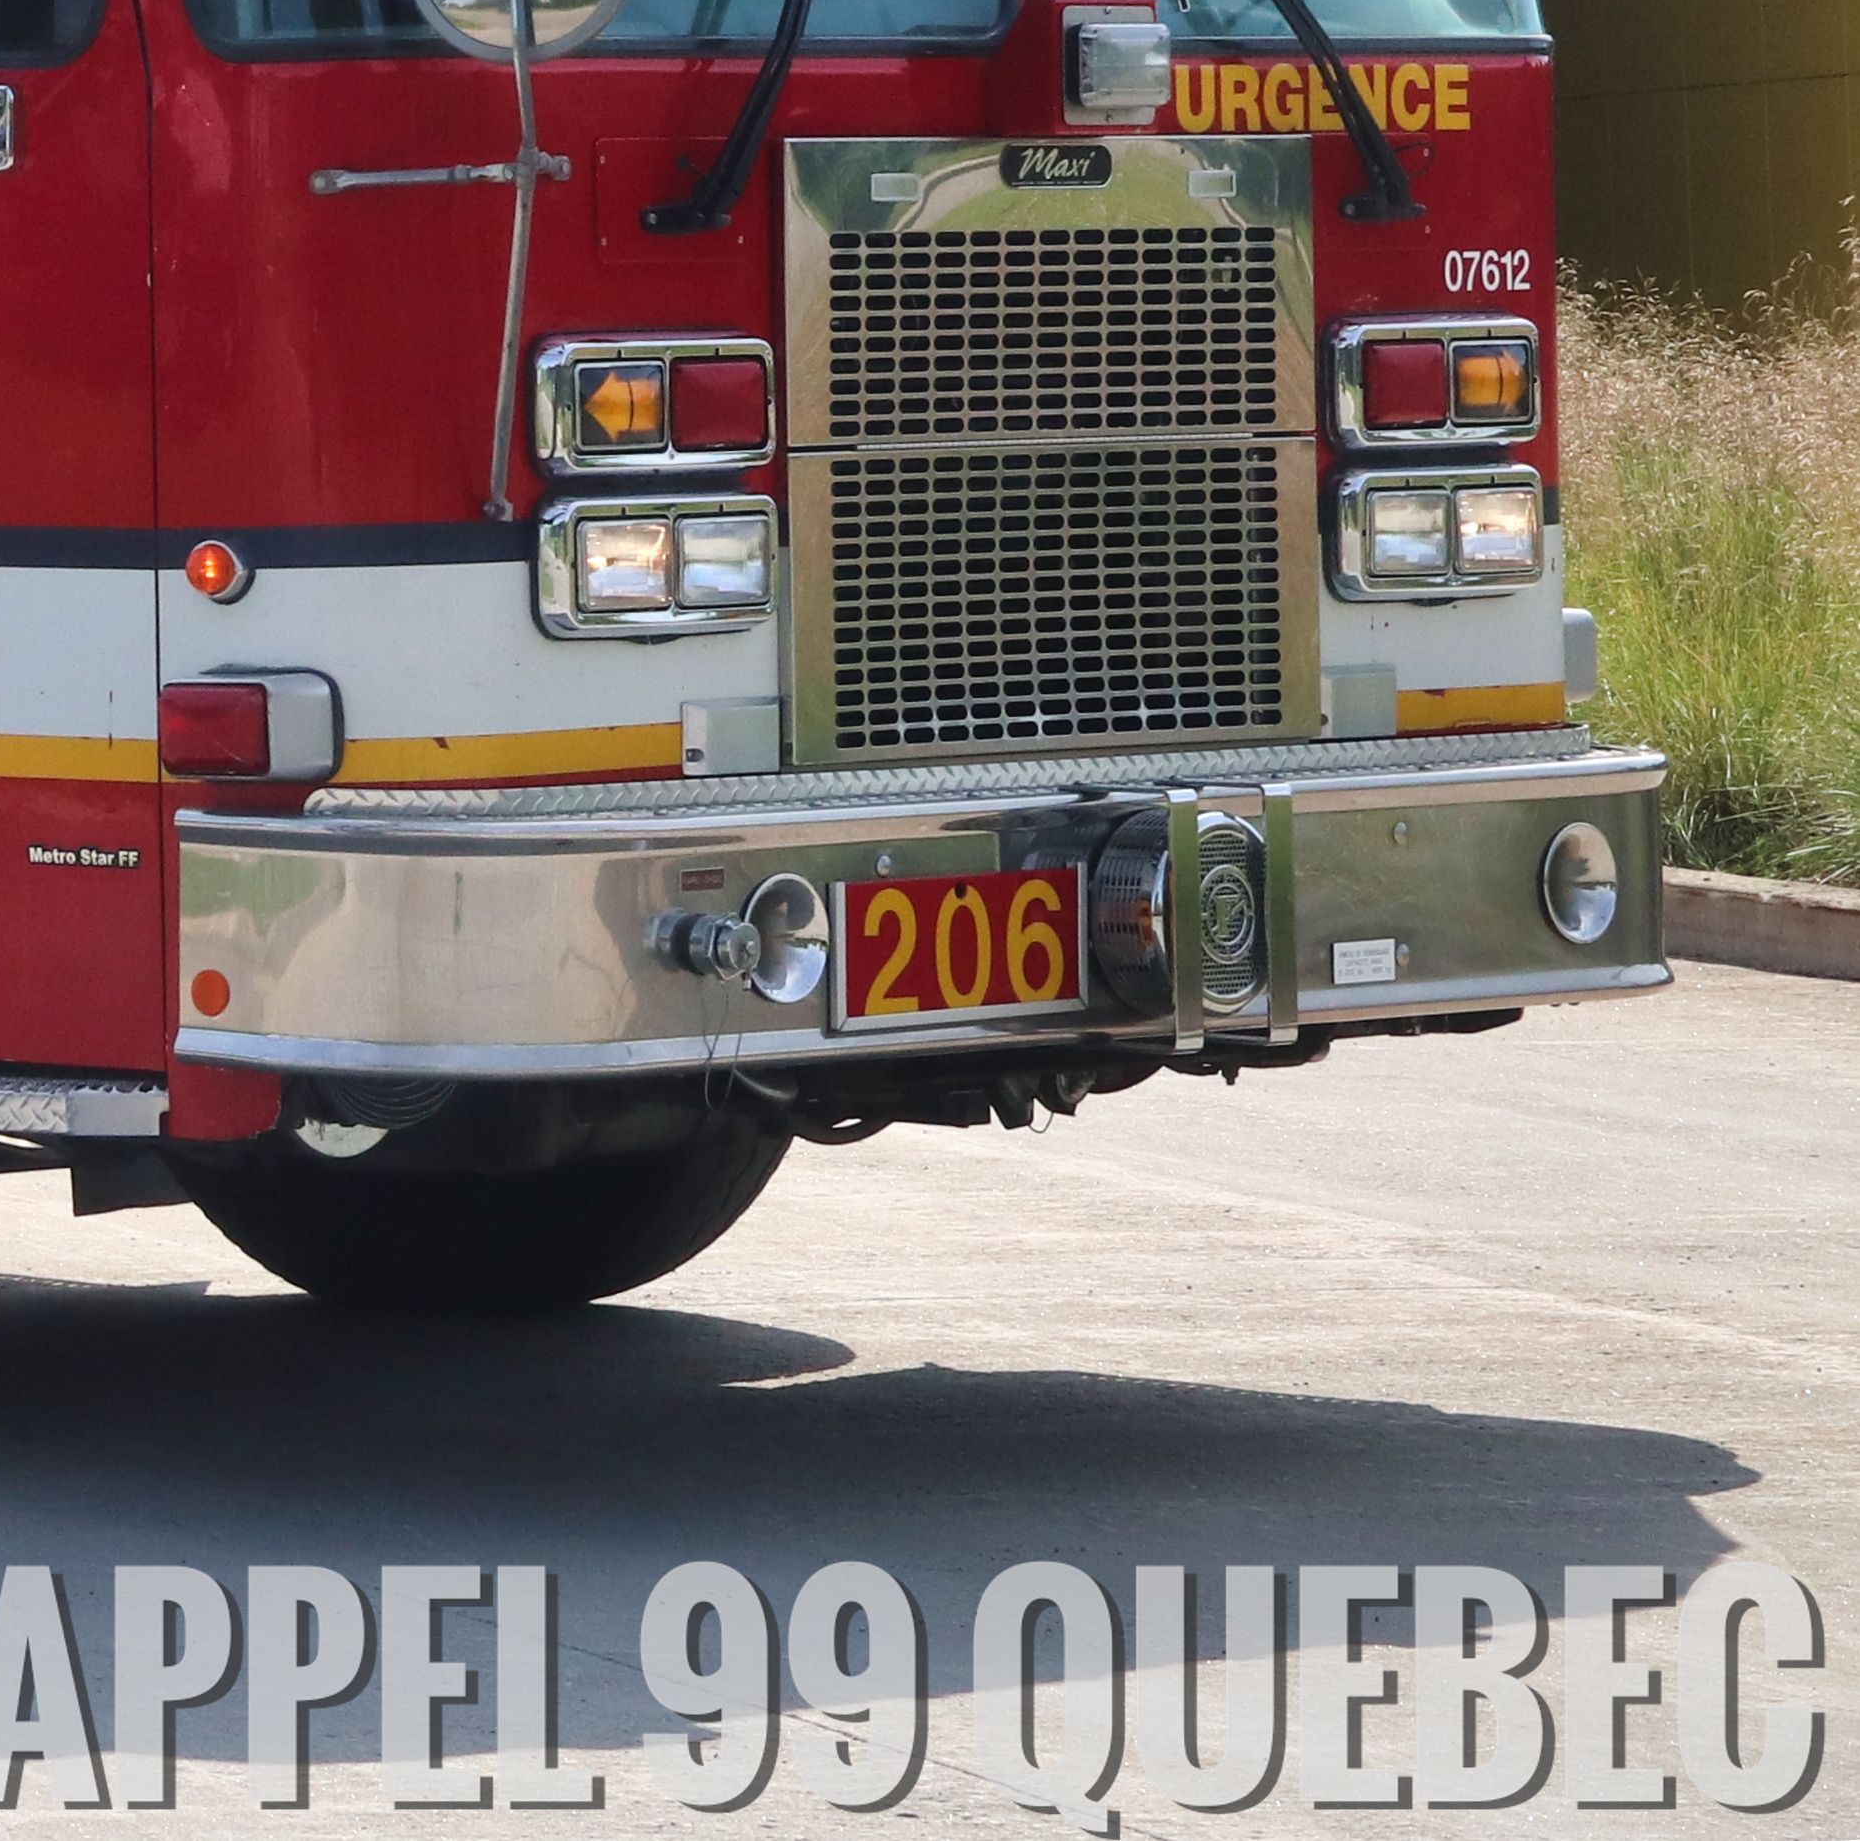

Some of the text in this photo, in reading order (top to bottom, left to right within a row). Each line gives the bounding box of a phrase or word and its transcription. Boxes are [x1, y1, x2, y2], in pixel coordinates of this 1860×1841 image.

[1175, 62, 1471, 134] URGENCE
[1018, 147, 1096, 180] Maxi
[1444, 249, 1531, 293] 07612
[28, 846, 139, 868] Metro Star FF
[864, 878, 1065, 1016] 206
